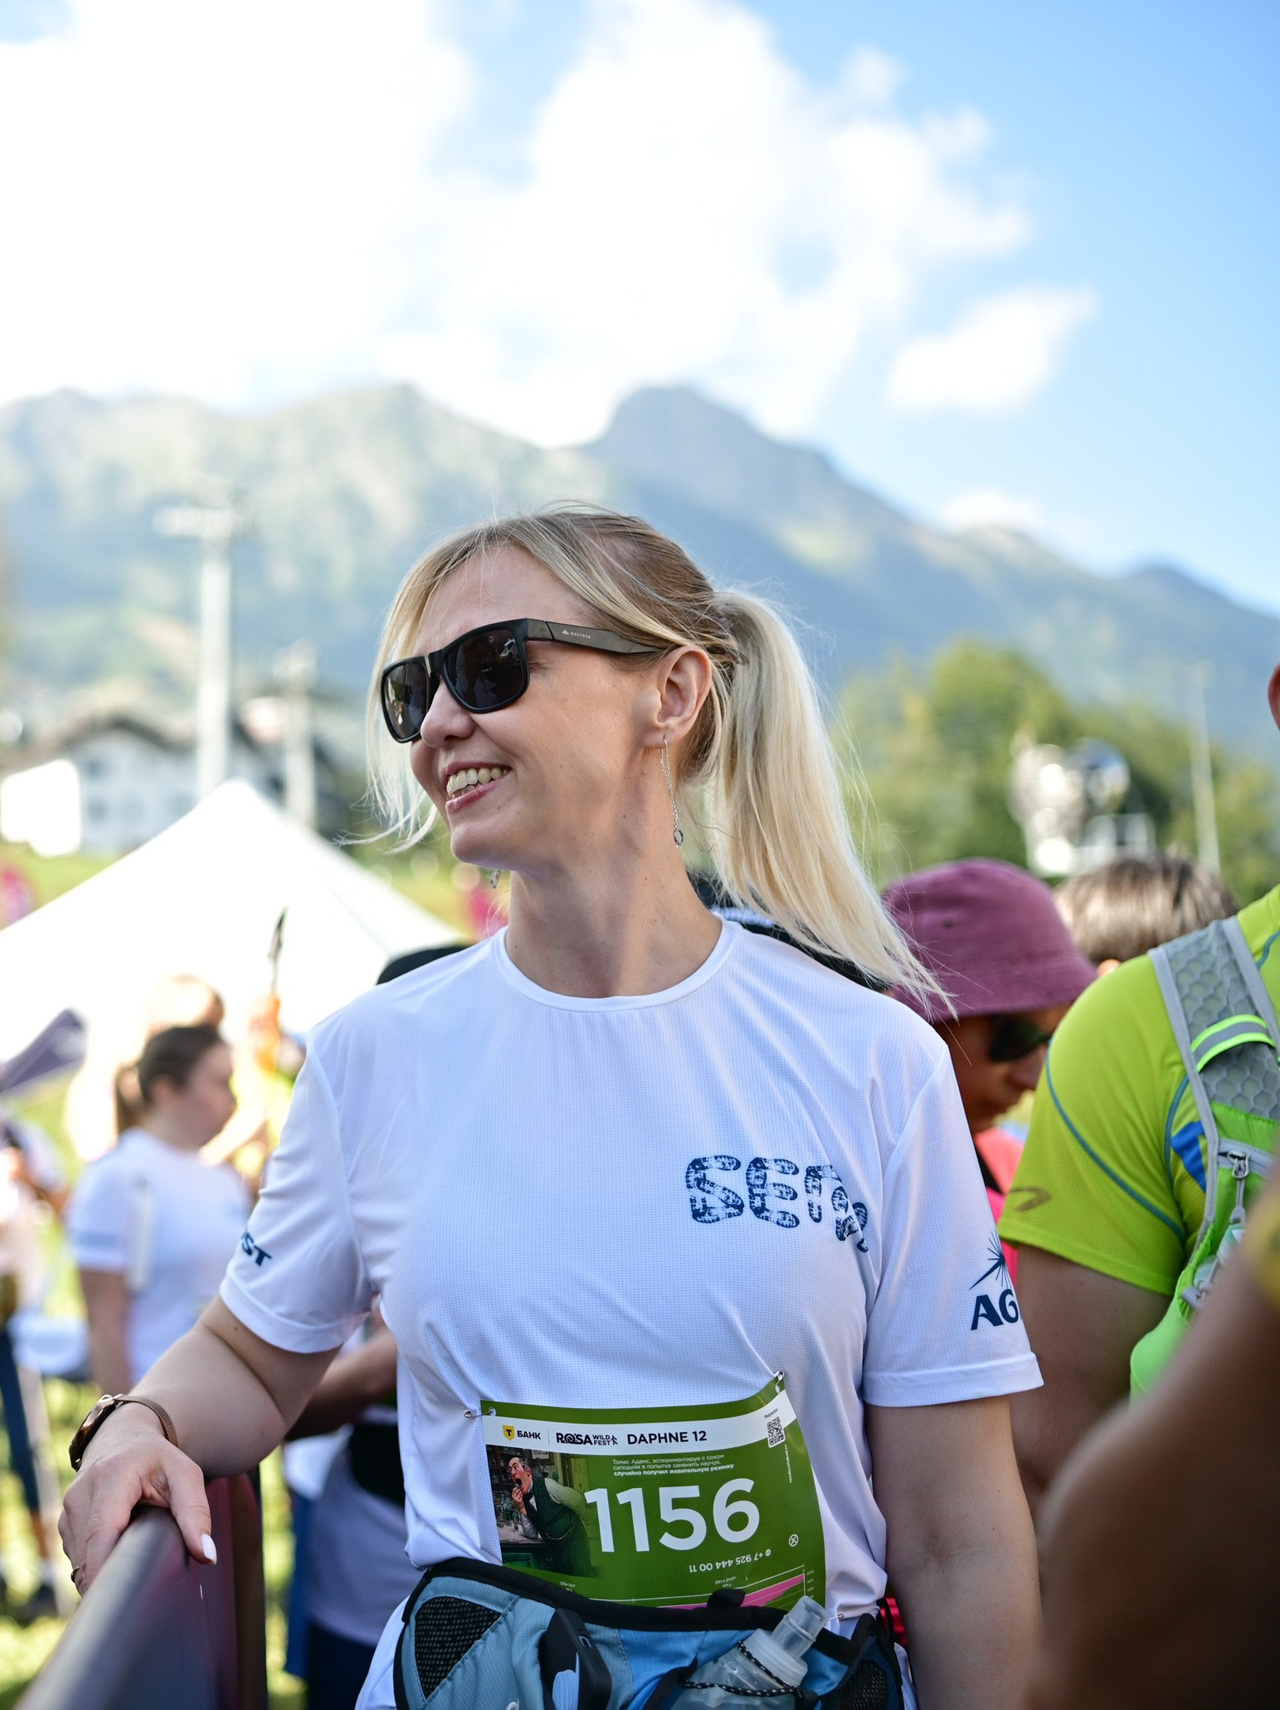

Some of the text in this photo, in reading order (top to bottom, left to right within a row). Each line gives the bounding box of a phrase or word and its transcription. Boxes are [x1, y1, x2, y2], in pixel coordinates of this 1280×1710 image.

[241, 1232, 272, 1267] ST
[516, 1430, 542, 1440] БАНК
[627, 1430, 708, 1445] DAPHNE 12
[584, 1477, 760, 1552] 1156
[688, 1552, 764, 1573] +7 925 444 00 11
